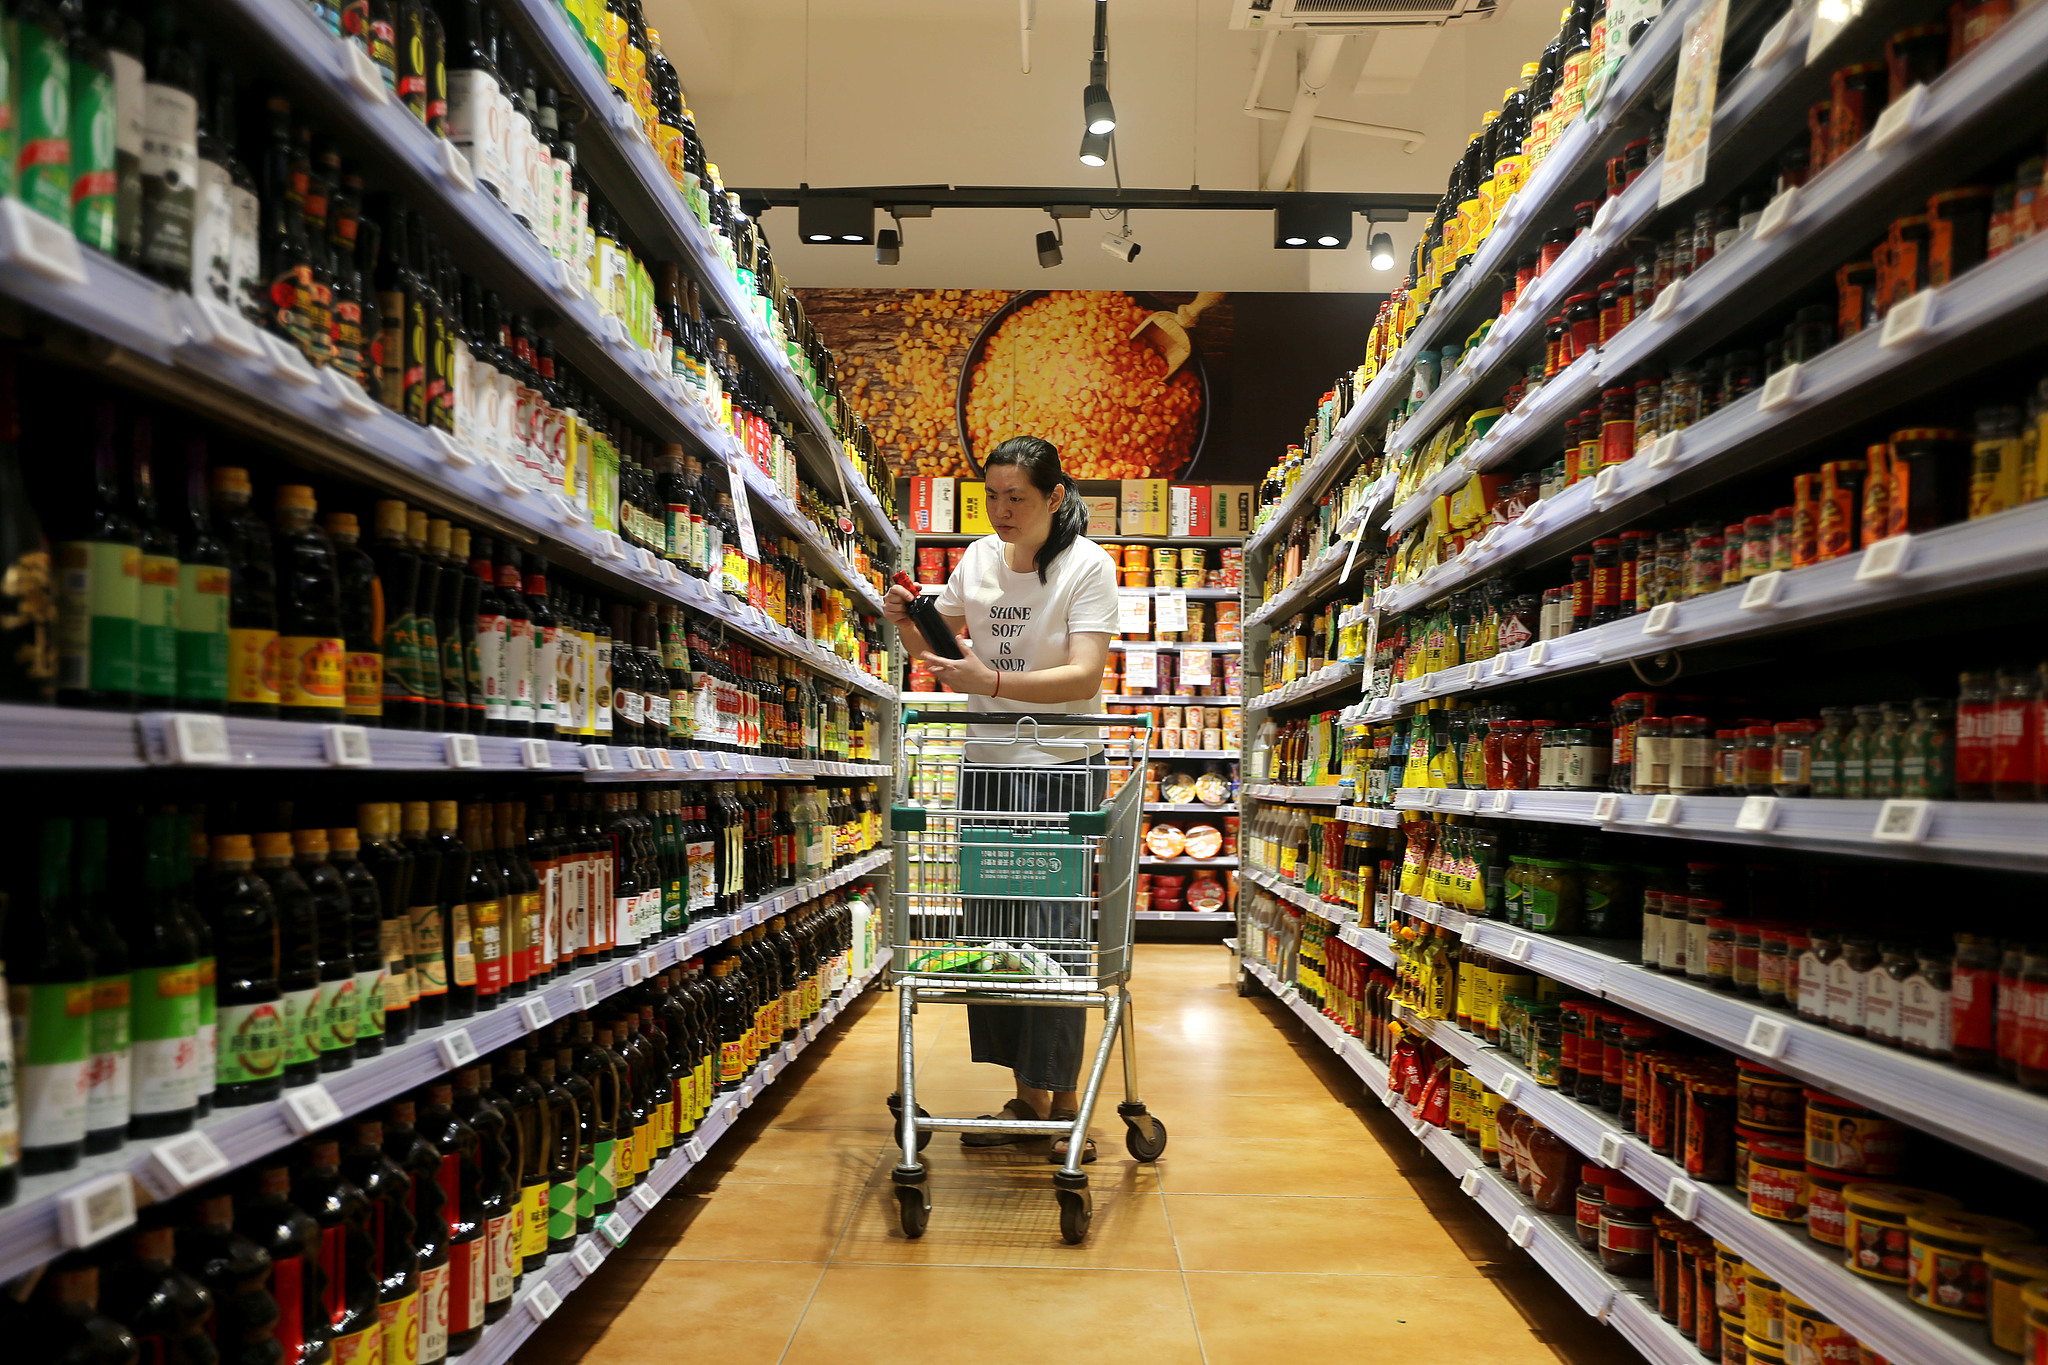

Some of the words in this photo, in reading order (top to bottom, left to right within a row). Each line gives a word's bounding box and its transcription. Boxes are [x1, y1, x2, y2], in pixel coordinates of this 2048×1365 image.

[989, 606, 1032, 620] SHINE
[991, 624, 1025, 637] SOFT
[1000, 642, 1011, 654] IS
[990, 658, 1025, 672] YOUR
